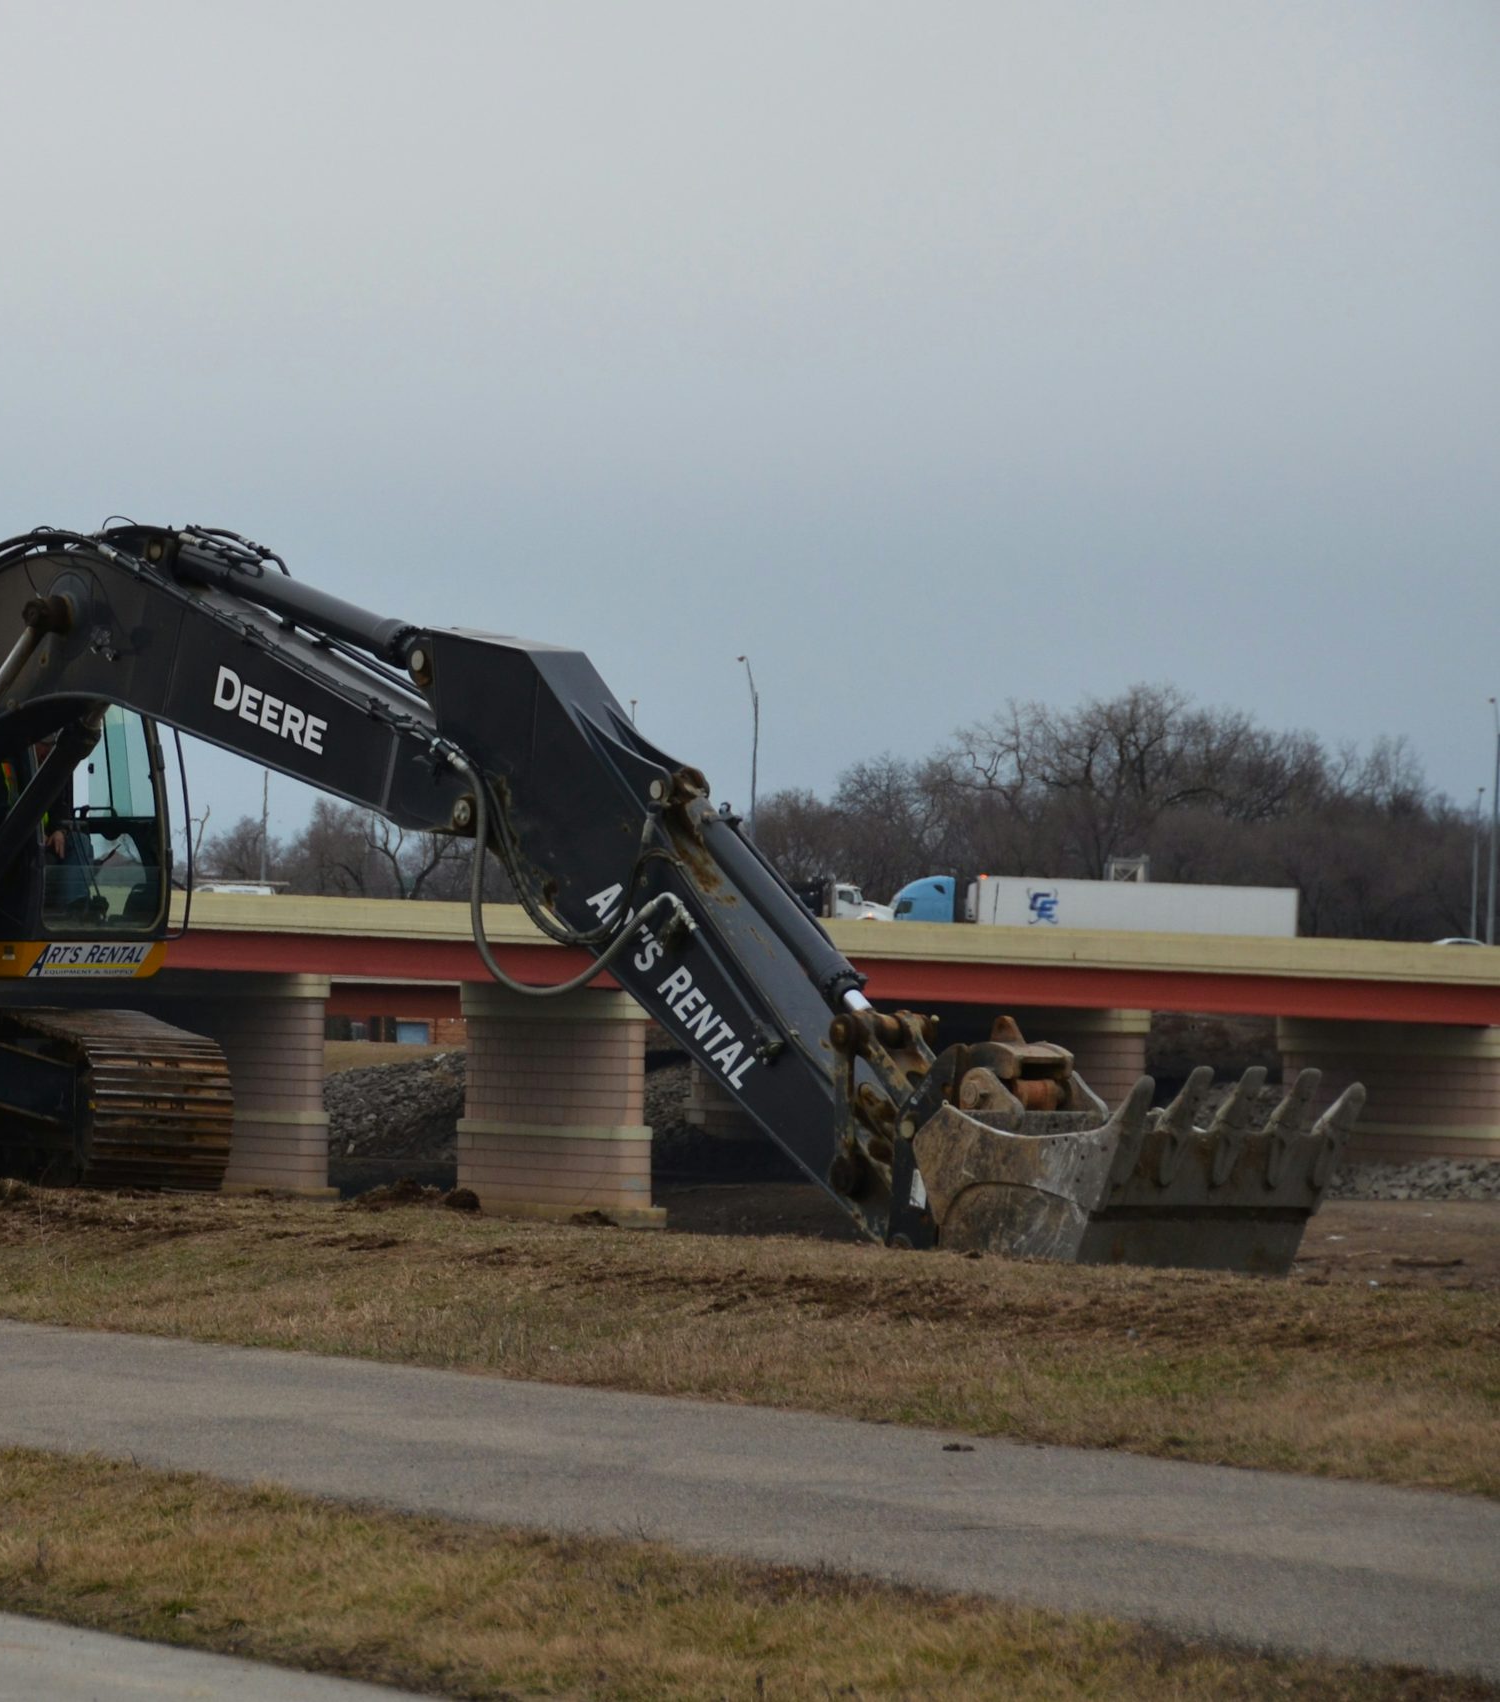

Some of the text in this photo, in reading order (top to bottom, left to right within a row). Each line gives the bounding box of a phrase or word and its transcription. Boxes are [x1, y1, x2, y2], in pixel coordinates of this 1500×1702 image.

[213, 665, 328, 755] DEERE
[26, 943, 144, 977] ART'S RENTAL
[656, 965, 757, 1090] RENTAL
